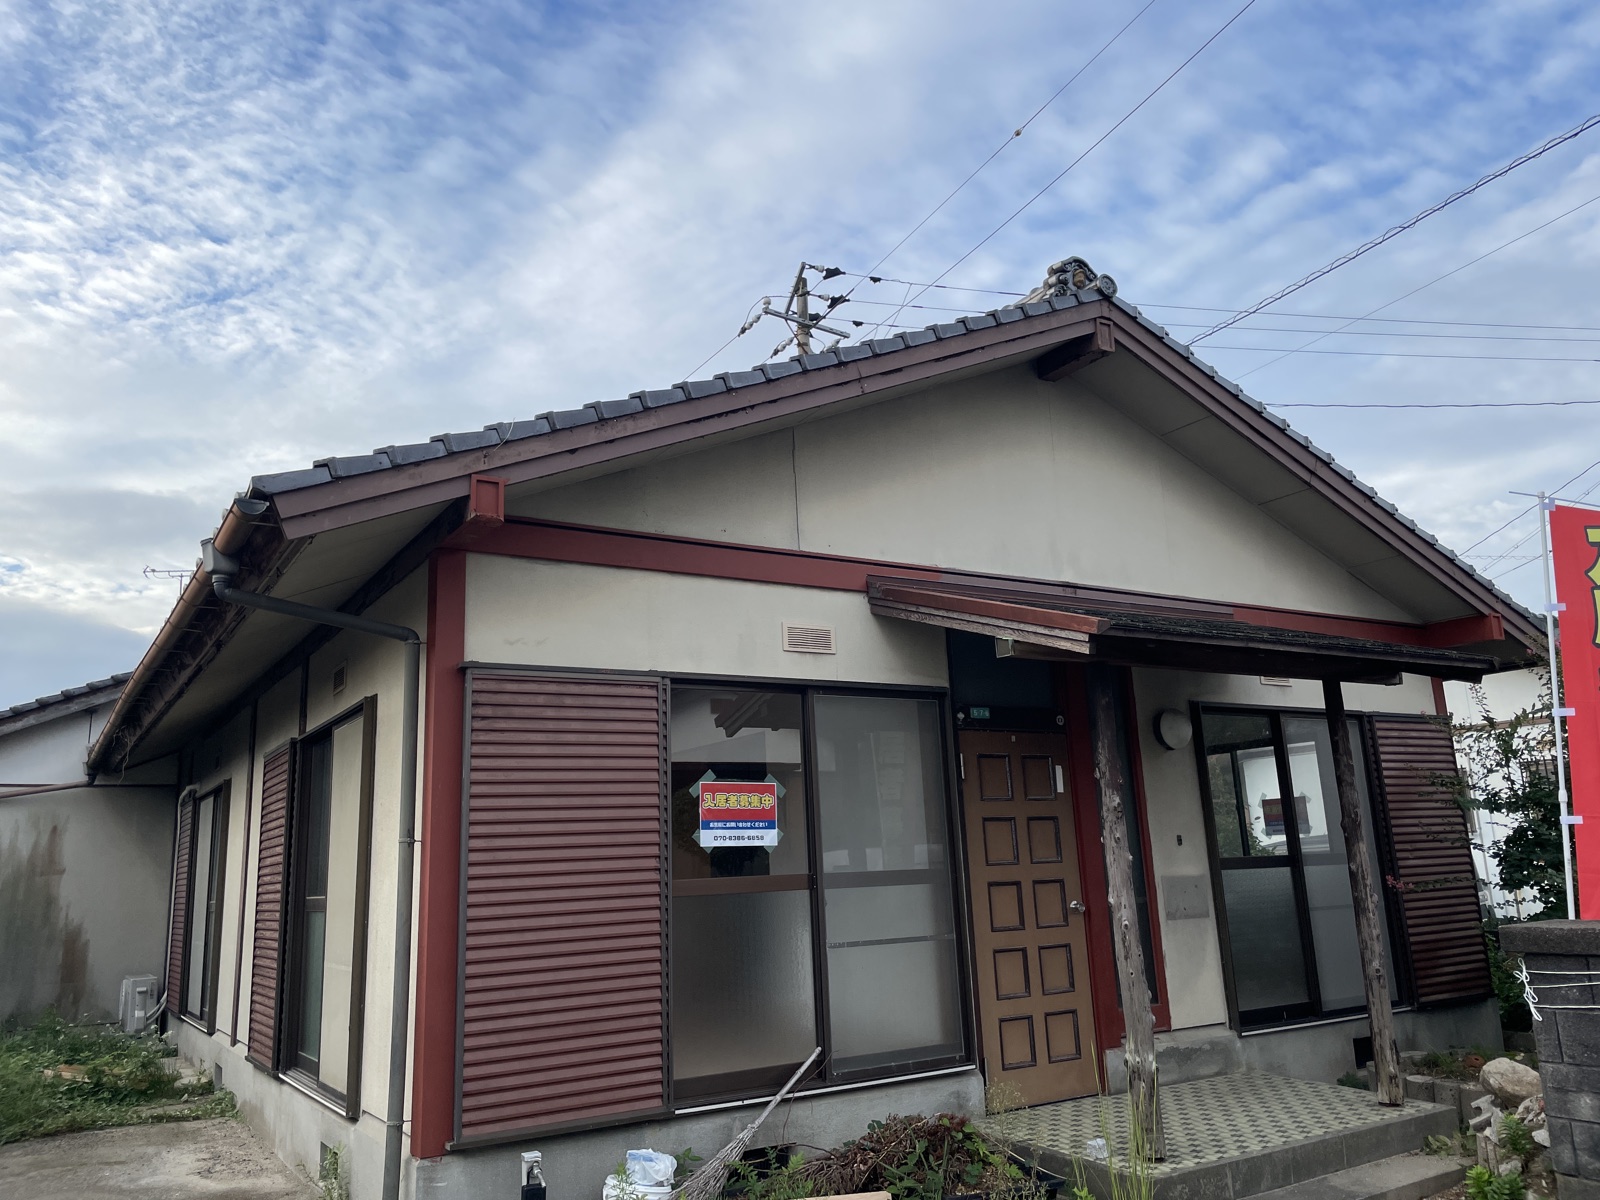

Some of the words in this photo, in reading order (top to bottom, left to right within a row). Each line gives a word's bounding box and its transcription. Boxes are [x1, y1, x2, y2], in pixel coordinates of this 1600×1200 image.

[702, 793, 774, 809] 入居者募集中
